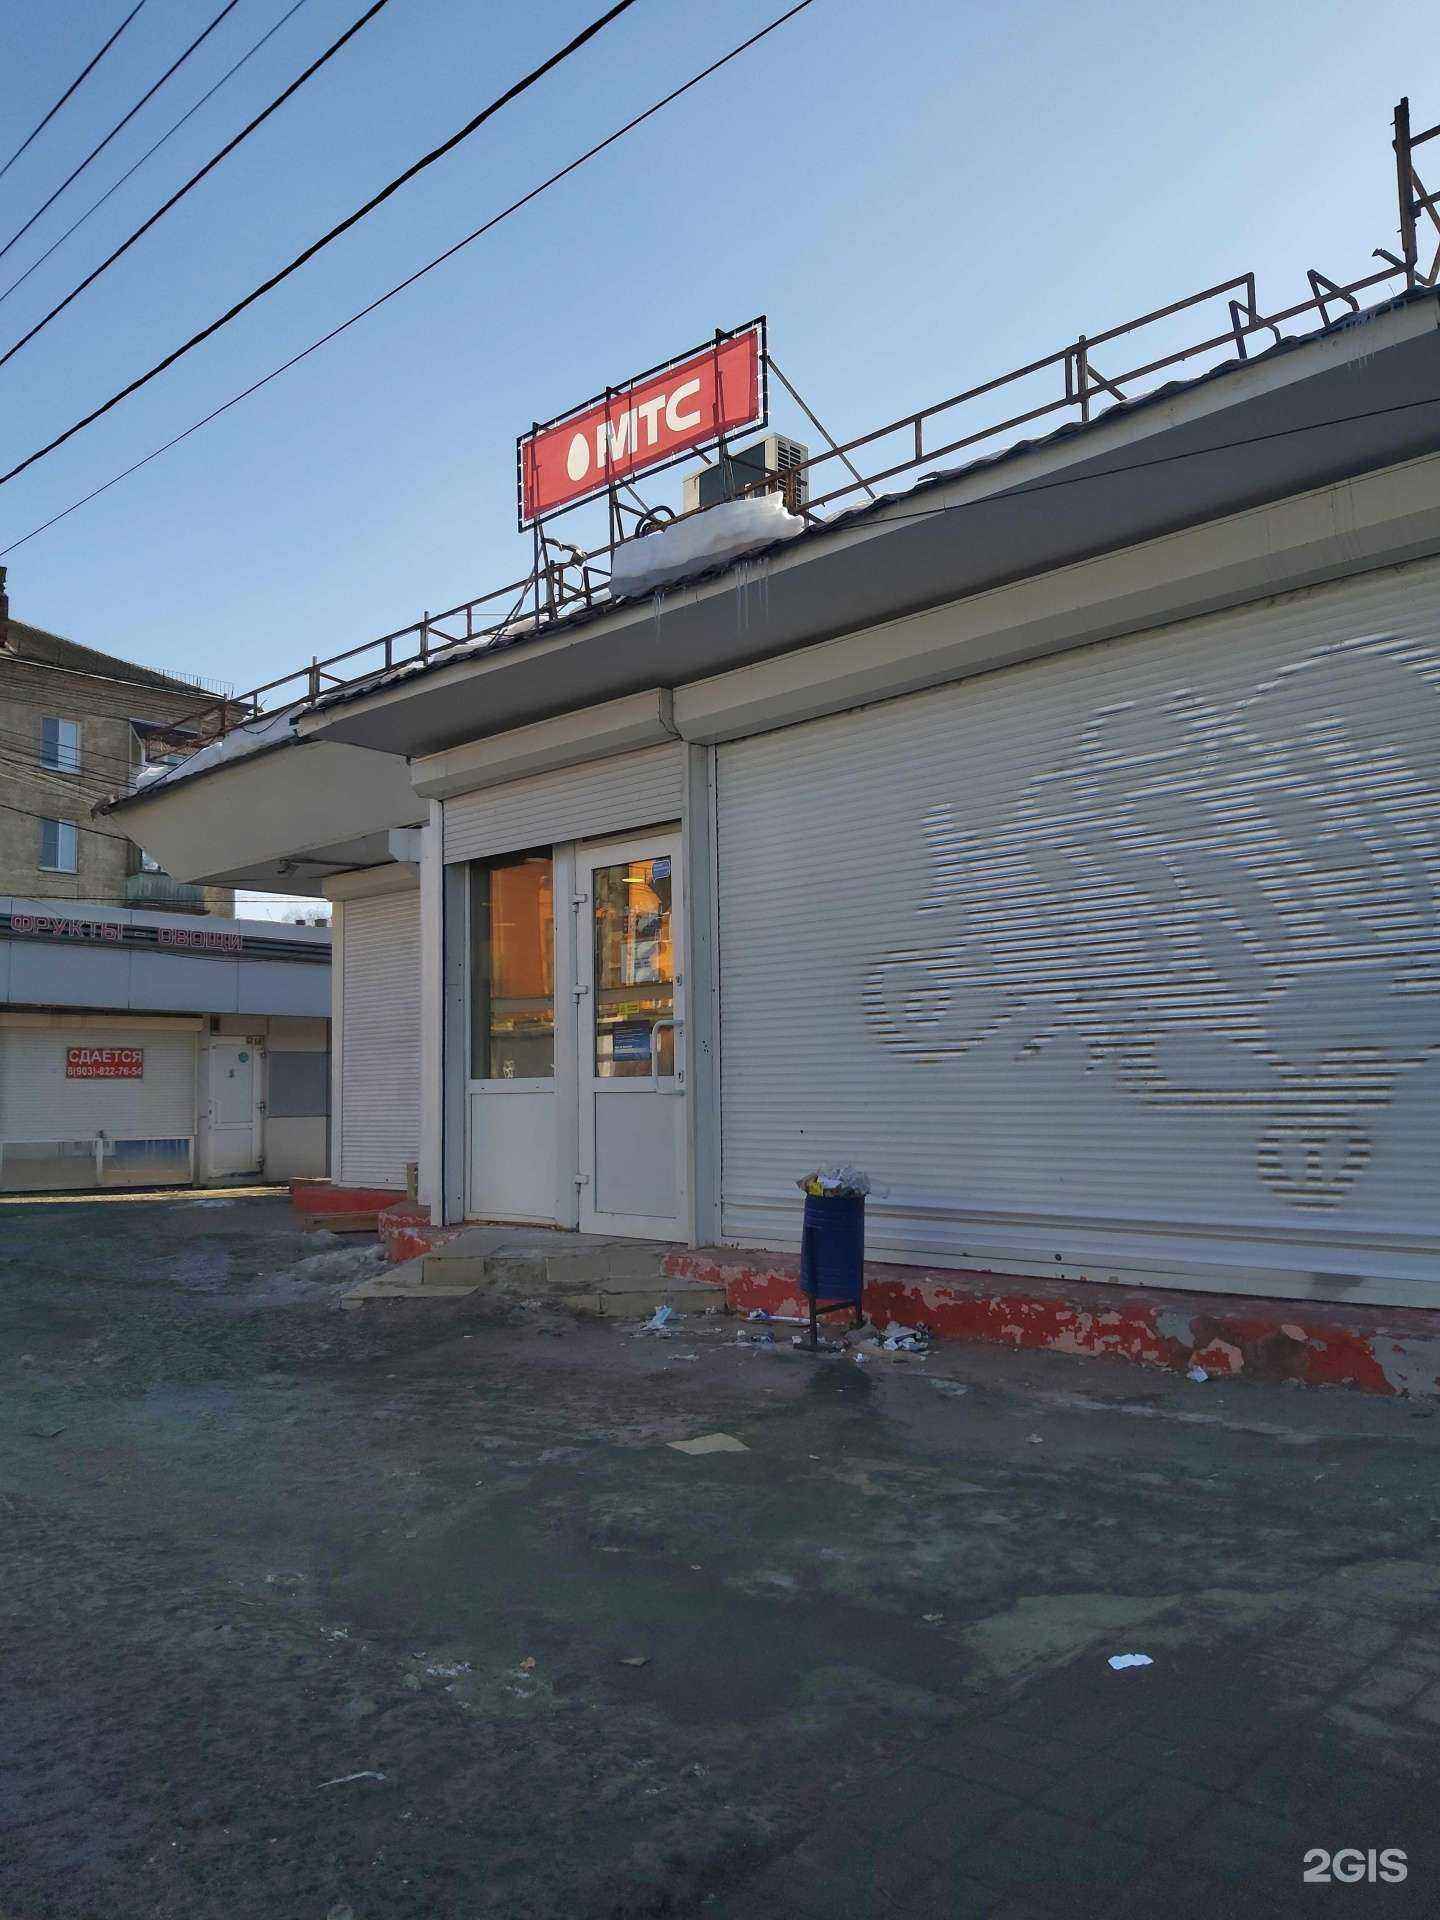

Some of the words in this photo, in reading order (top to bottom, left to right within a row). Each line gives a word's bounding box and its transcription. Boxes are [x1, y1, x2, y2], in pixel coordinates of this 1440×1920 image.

[596, 378, 701, 468] МТС
[11, 914, 123, 941] ФРУКТЫ
[159, 928, 243, 952] ОВОЩИ
[69, 1049, 142, 1064] СДАЕТСЯ
